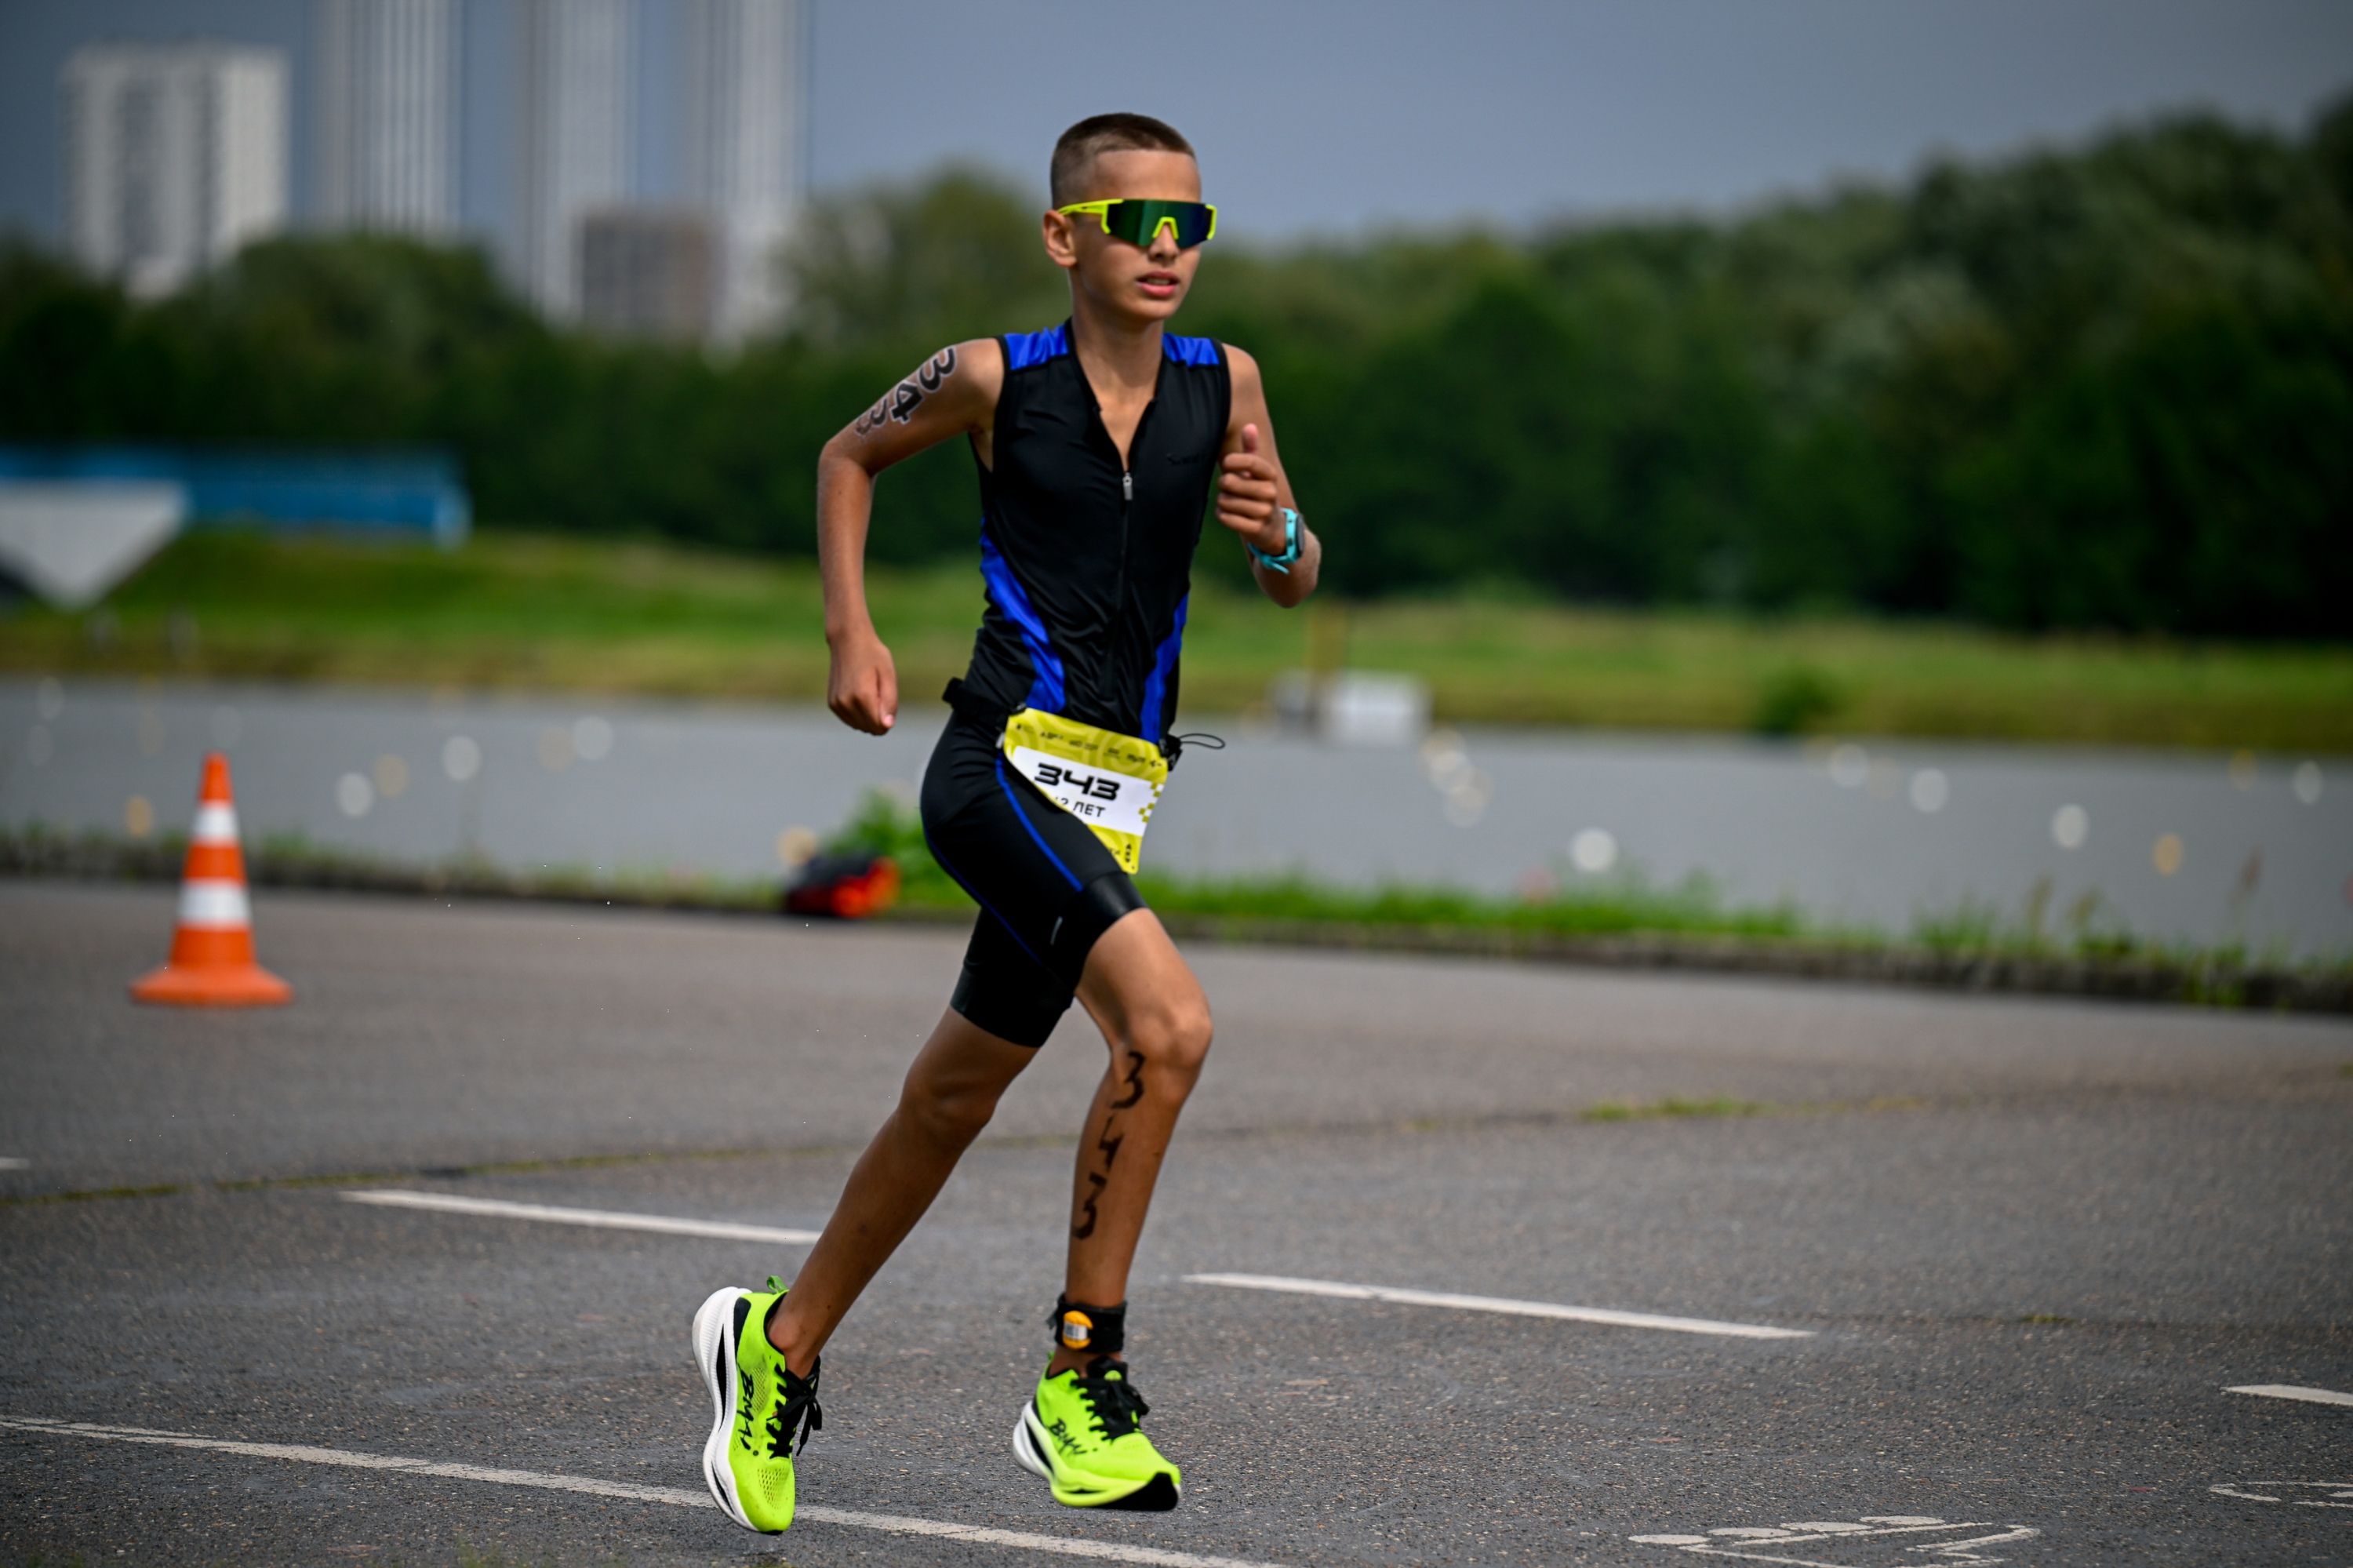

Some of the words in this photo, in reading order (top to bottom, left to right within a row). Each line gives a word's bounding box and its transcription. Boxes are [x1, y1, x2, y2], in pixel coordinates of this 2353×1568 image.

[1035, 762, 1120, 801] 343
[1073, 801, 1106, 817] ЛЕТ
[1071, 1051, 1145, 1240] 343
[736, 1363, 761, 1450] BMAI
